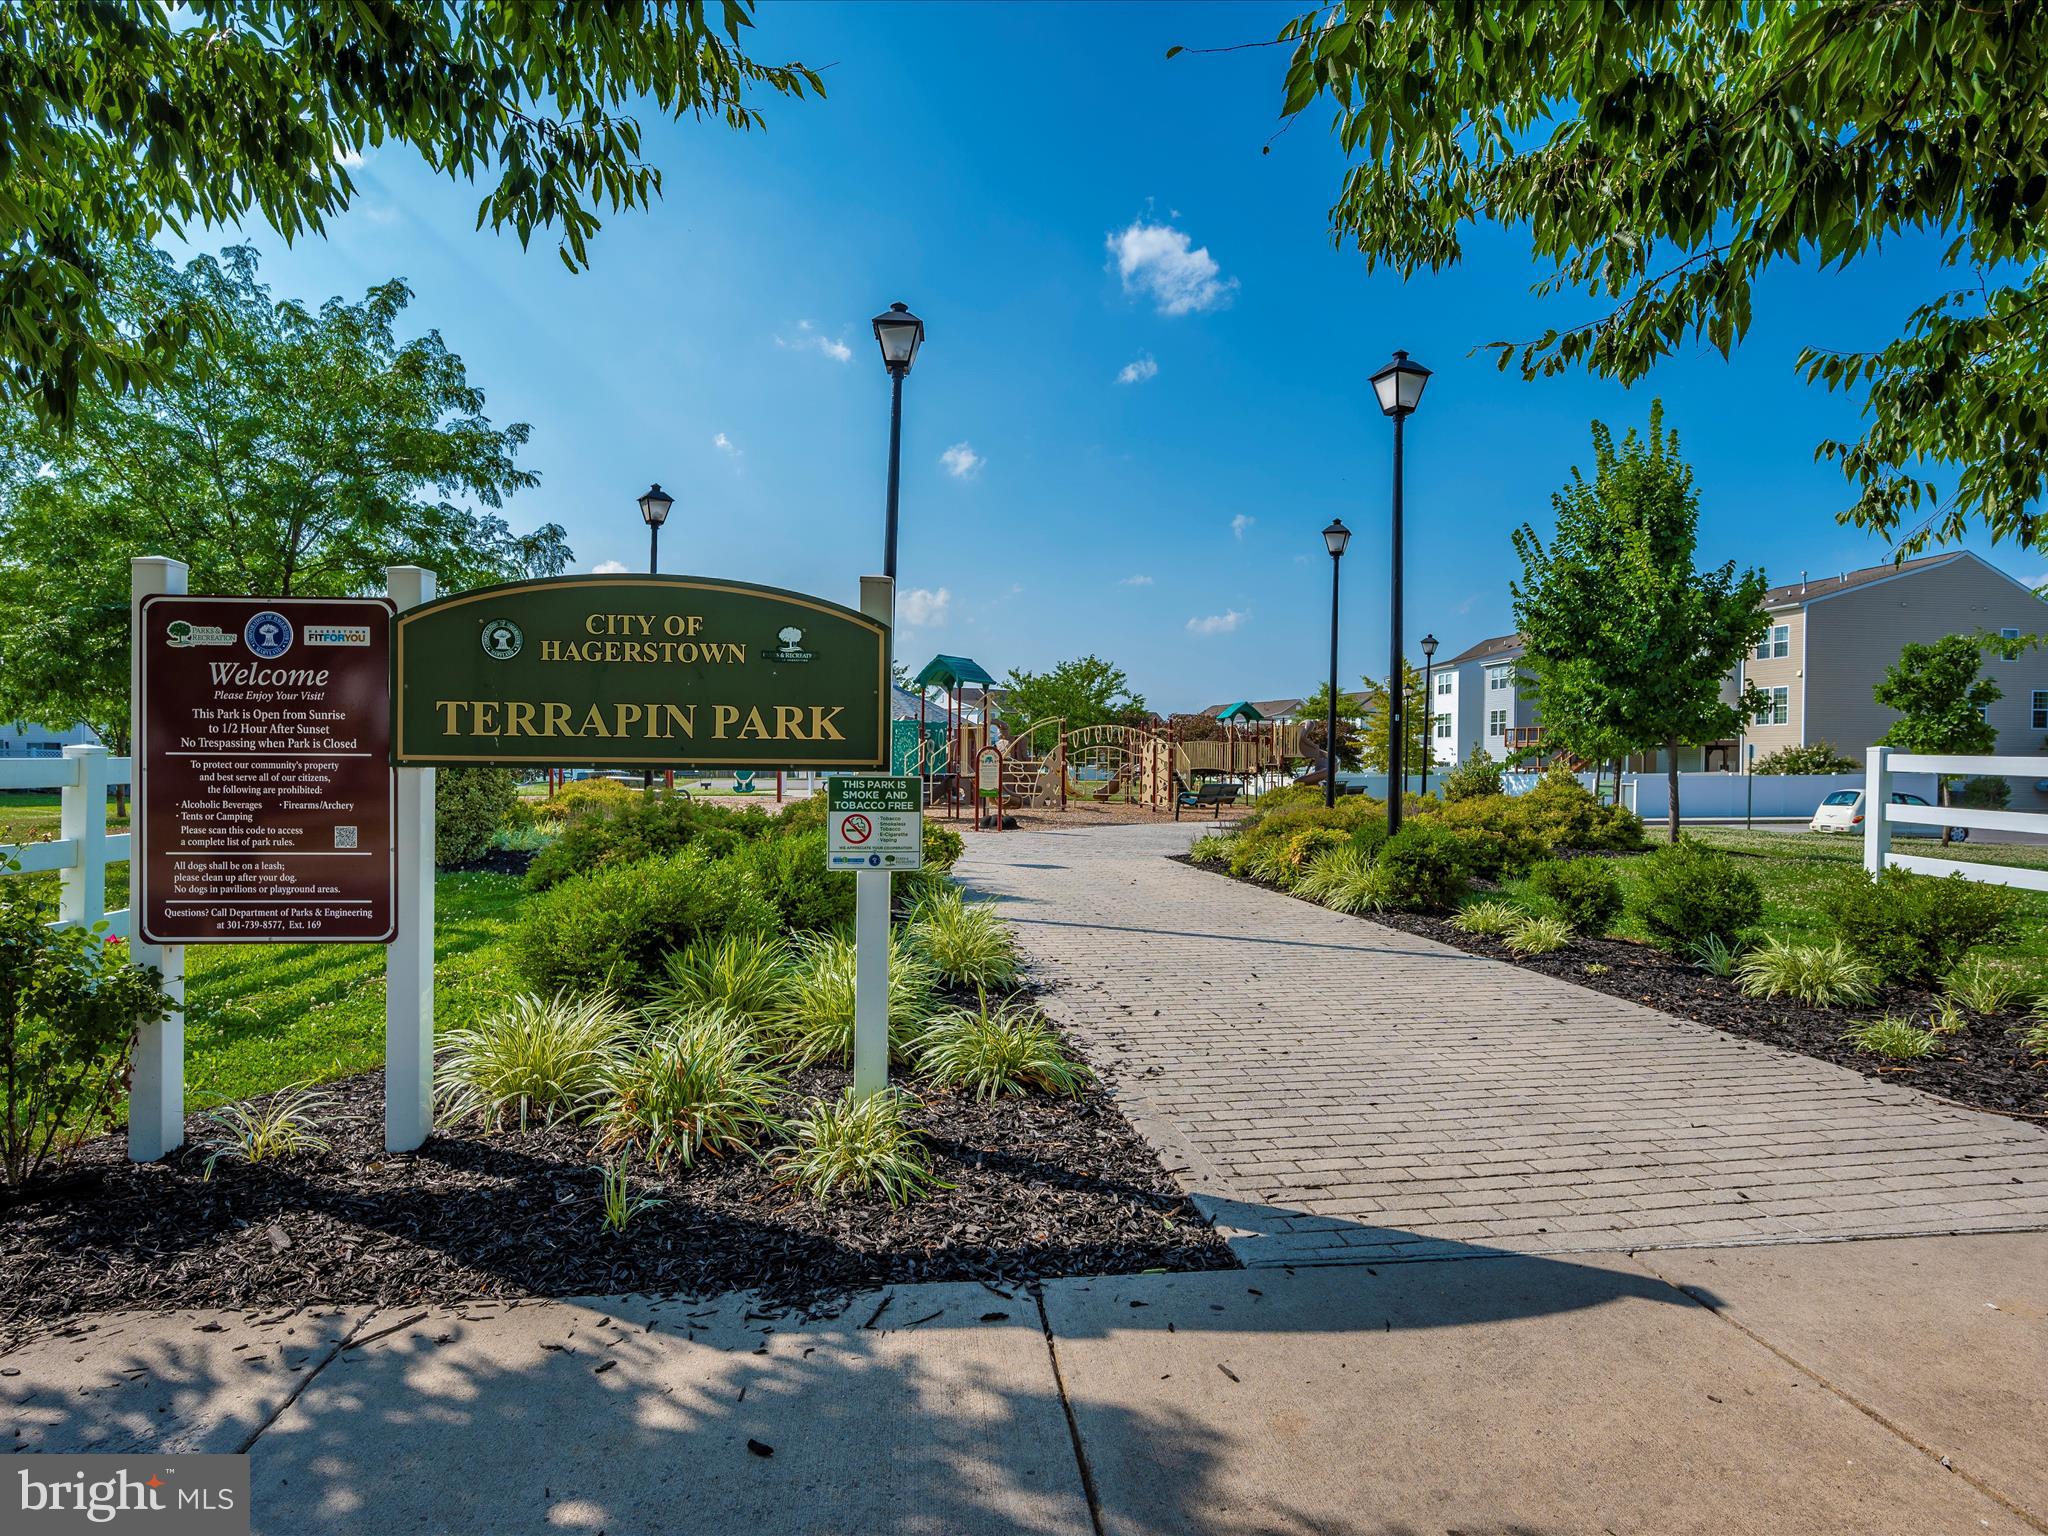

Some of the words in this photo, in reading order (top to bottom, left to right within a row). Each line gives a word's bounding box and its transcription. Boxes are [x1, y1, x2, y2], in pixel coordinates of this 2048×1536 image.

[586, 614, 656, 635] CITY
[664, 616, 703, 636] OF
[541, 641, 746, 663] HAGERSTOWN
[209, 662, 329, 686] Welcome
[214, 691, 243, 699] Please
[246, 691, 273, 702] Enjoy
[276, 691, 298, 700] Your
[301, 692, 324, 700] Visit!
[192, 709, 214, 718] This
[217, 709, 240, 719] Park
[243, 709, 250, 719] is
[253, 709, 279, 722] Open
[283, 709, 306, 719] from
[309, 710, 345, 720] Sunrise
[436, 701, 697, 738] TERRAPIN
[712, 705, 846, 740] PARK
[209, 725, 219, 733] to
[223, 723, 237, 733] 1/2
[241, 724, 267, 733] Hour
[270, 723, 294, 733] After
[297, 724, 329, 734] Sunset
[181, 738, 196, 747] No
[198, 738, 256, 750] Trespassing
[258, 738, 284, 748] when
[288, 738, 310, 748] Park
[313, 739, 321, 748] is
[323, 738, 356, 748] Closed
[190, 760, 201, 768] To
[203, 762, 232, 771] protect
[251, 761, 302, 771] community's
[304, 763, 339, 771] property
[200, 773, 214, 781] and
[217, 773, 233, 781] best
[259, 773, 268, 781] all
[271, 773, 280, 781] of
[298, 773, 330, 783] citizens,
[208, 785, 221, 793] the
[223, 785, 261, 796] following
[278, 786, 322, 796] prohibited:
[842, 781, 865, 789] THIS
[868, 781, 895, 789] PARK
[898, 781, 906, 789] IS
[843, 791, 879, 799] SMOKE
[885, 791, 908, 799] AND
[181, 800, 220, 808] Alcoholic
[223, 801, 262, 811] Beverages
[284, 801, 354, 811] Firearms/Archery
[835, 801, 885, 810] TOBACCO
[888, 802, 913, 810] FREE
[181, 812, 203, 820] Tents
[216, 812, 253, 822] Camping
[181, 826, 206, 834] Please
[229, 826, 244, 834] this
[246, 826, 265, 834] code
[188, 837, 225, 848] complete
[227, 837, 239, 845] list
[241, 837, 250, 845] of
[252, 838, 270, 848] park
[273, 838, 295, 846] rules.
[174, 861, 185, 869] All
[188, 861, 207, 872] dogs
[209, 861, 228, 869] shall
[230, 862, 239, 870] be
[262, 861, 284, 871] leash;
[174, 873, 199, 883] please
[202, 873, 223, 881] clean
[225, 875, 236, 883] up
[238, 873, 257, 881] after
[259, 875, 278, 883] your
[280, 873, 297, 883] dog.
[174, 885, 186, 893] No
[189, 885, 207, 895] dogs
[210, 885, 217, 893] in
[220, 885, 256, 895] pavilions
[270, 885, 315, 895] playground
[165, 908, 209, 918] Questions?
[211, 908, 227, 916] Call
[230, 909, 278, 918] Department
[280, 908, 289, 916] of
[292, 908, 313, 916] Parks
[315, 908, 322, 916] &
[325, 908, 372, 919] Engineering
[227, 921, 284, 930] 301-739-8577,
